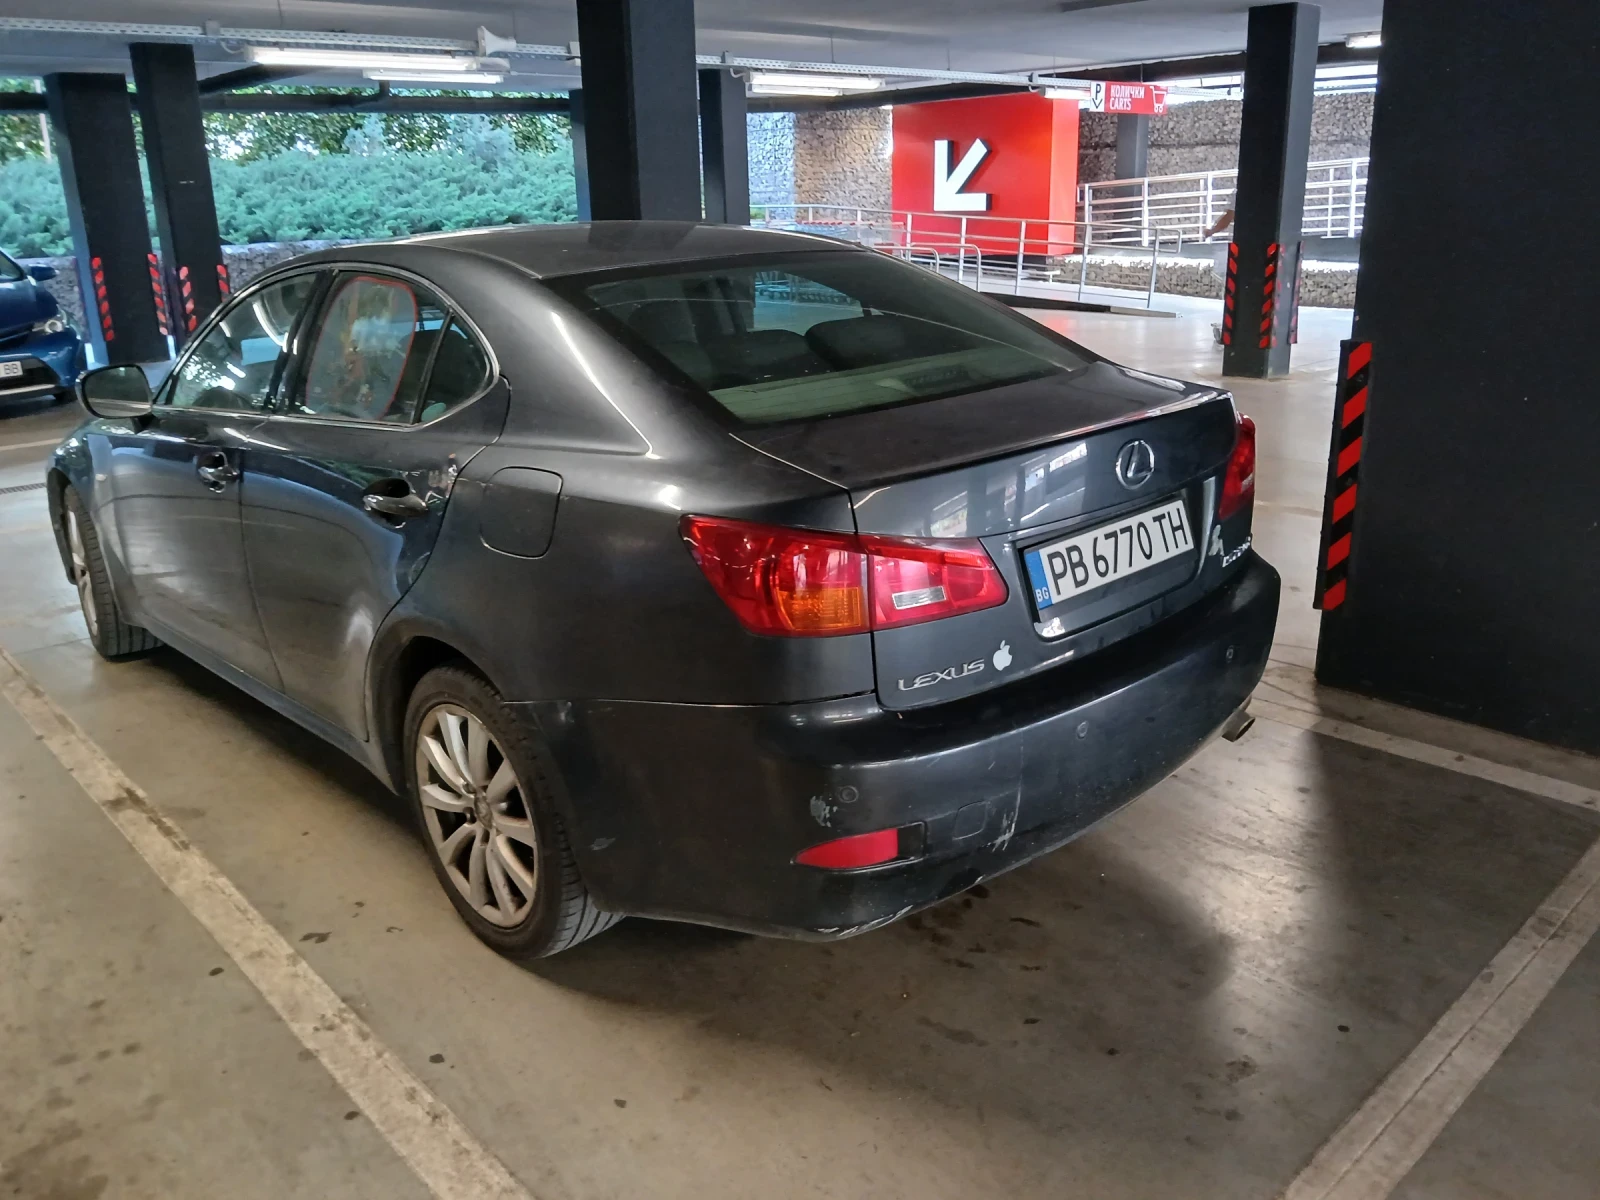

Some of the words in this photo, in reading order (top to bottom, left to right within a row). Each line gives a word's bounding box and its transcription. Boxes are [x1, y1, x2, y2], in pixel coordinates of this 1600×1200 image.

[1095, 83, 1102, 100] P
[1110, 85, 1145, 99] КОЛИЧКИ
[1109, 98, 1132, 111] CARTS
[1046, 544, 1090, 596] PB
[1092, 521, 1153, 578] 6770
[1152, 507, 1189, 554] TH
[1035, 587, 1050, 603] BG
[898, 659, 985, 691] LEXUS
